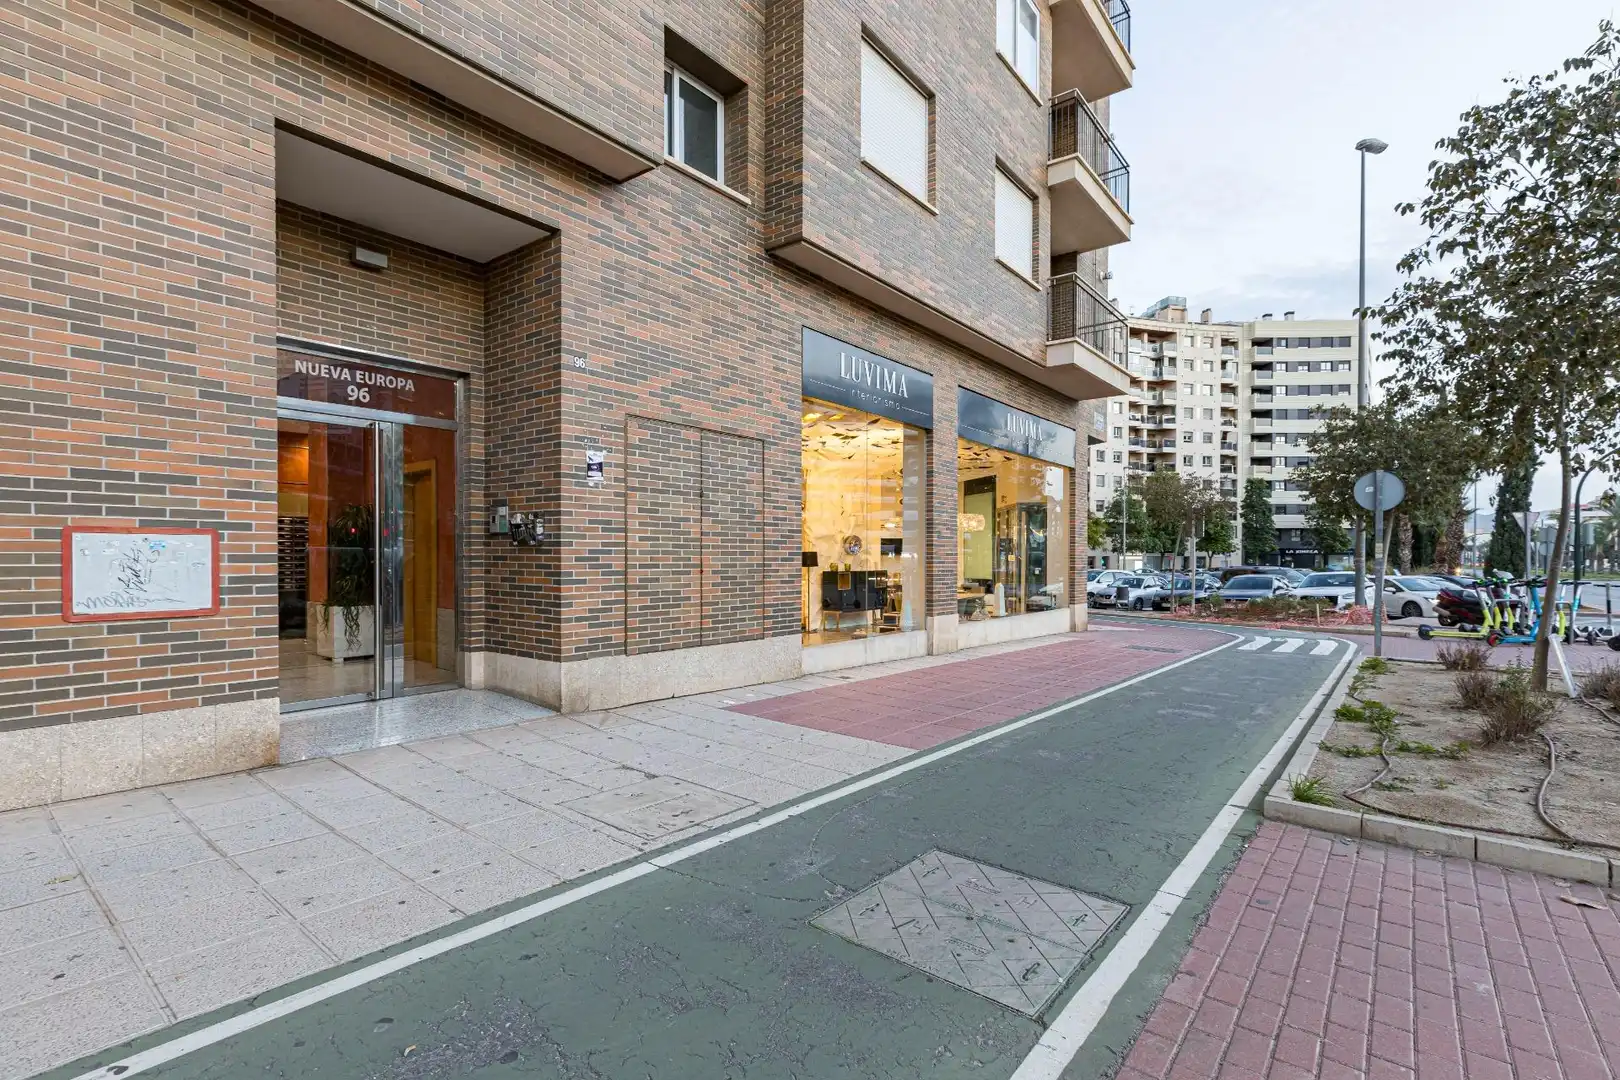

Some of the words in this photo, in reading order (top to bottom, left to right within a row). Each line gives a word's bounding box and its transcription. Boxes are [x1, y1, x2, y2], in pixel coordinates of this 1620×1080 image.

[294, 359, 352, 382] NUEVA
[355, 370, 415, 392] EUROPA
[573, 356, 586, 368] 96
[839, 352, 909, 398] LUVIMA
[346, 385, 371, 403] 96
[1007, 413, 1043, 441] LUVIMA
